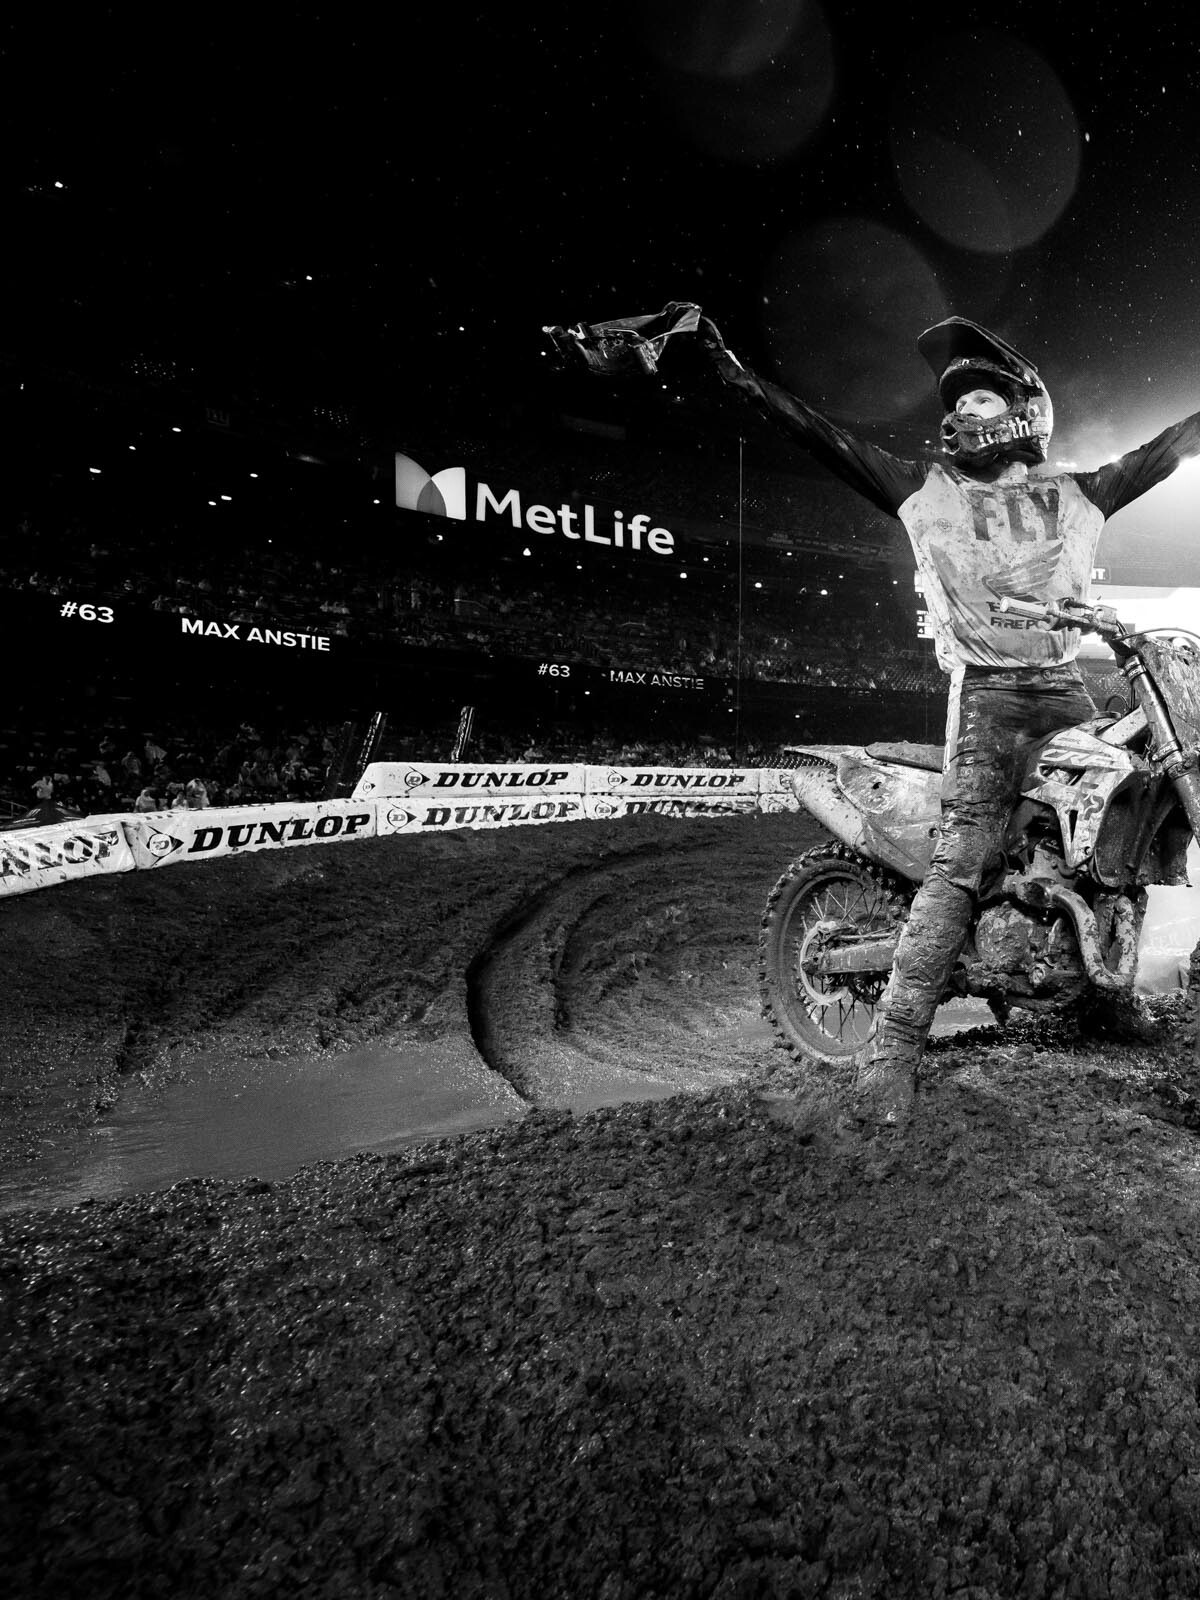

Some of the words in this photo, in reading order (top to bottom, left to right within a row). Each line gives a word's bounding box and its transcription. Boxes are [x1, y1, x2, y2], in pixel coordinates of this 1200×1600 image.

[476, 482, 676, 556] MetLife
[966, 487, 1060, 541] FLY
[60, 600, 115, 624] #63
[181, 617, 241, 650] MAX
[247, 627, 331, 662] ANSTIE
[537, 662, 571, 678] #63
[610, 670, 647, 685] MAX
[650, 674, 705, 690] ANSTIE
[432, 770, 569, 788] DUNLOP
[630, 773, 746, 789] DUNLOP
[422, 801, 581, 828] DUNLOP
[187, 813, 371, 854] DUNLOP
